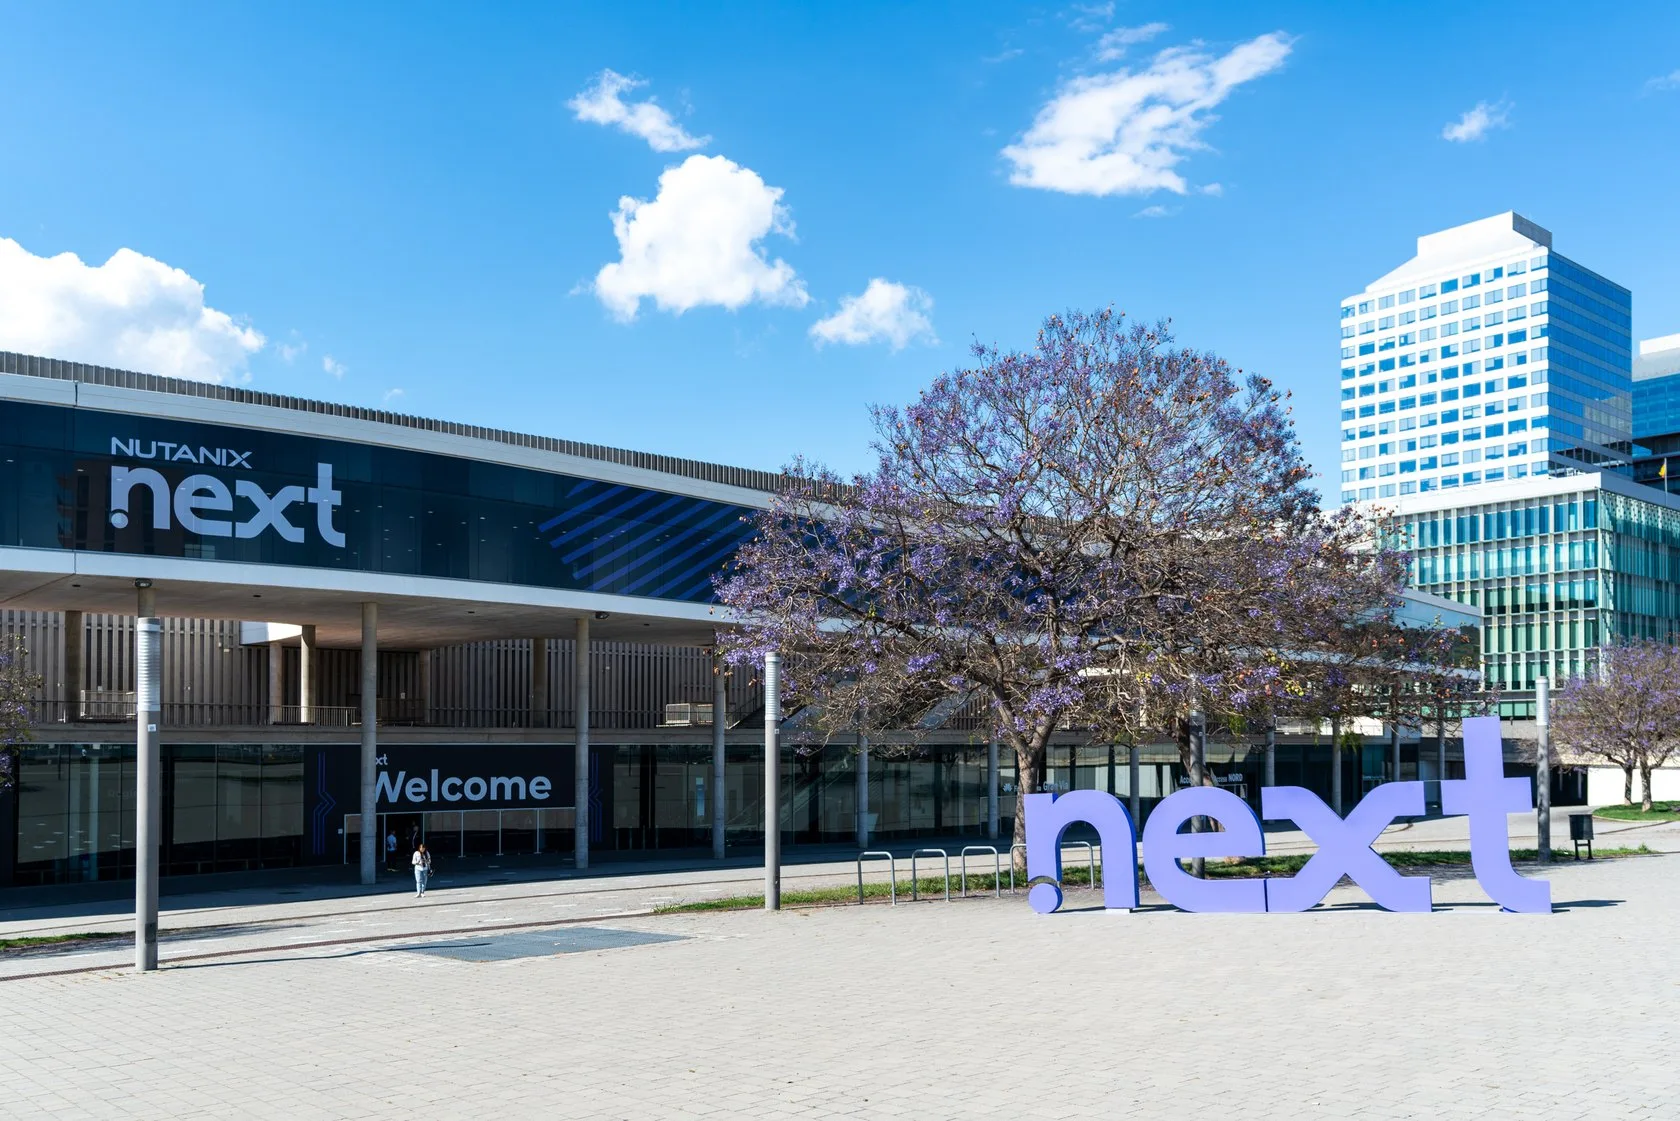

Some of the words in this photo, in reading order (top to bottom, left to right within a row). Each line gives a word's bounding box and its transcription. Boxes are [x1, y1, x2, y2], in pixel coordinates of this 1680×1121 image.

[111, 436, 252, 469] NUTANIX
[376, 754, 388, 765] xt
[376, 768, 552, 803] Welcome
